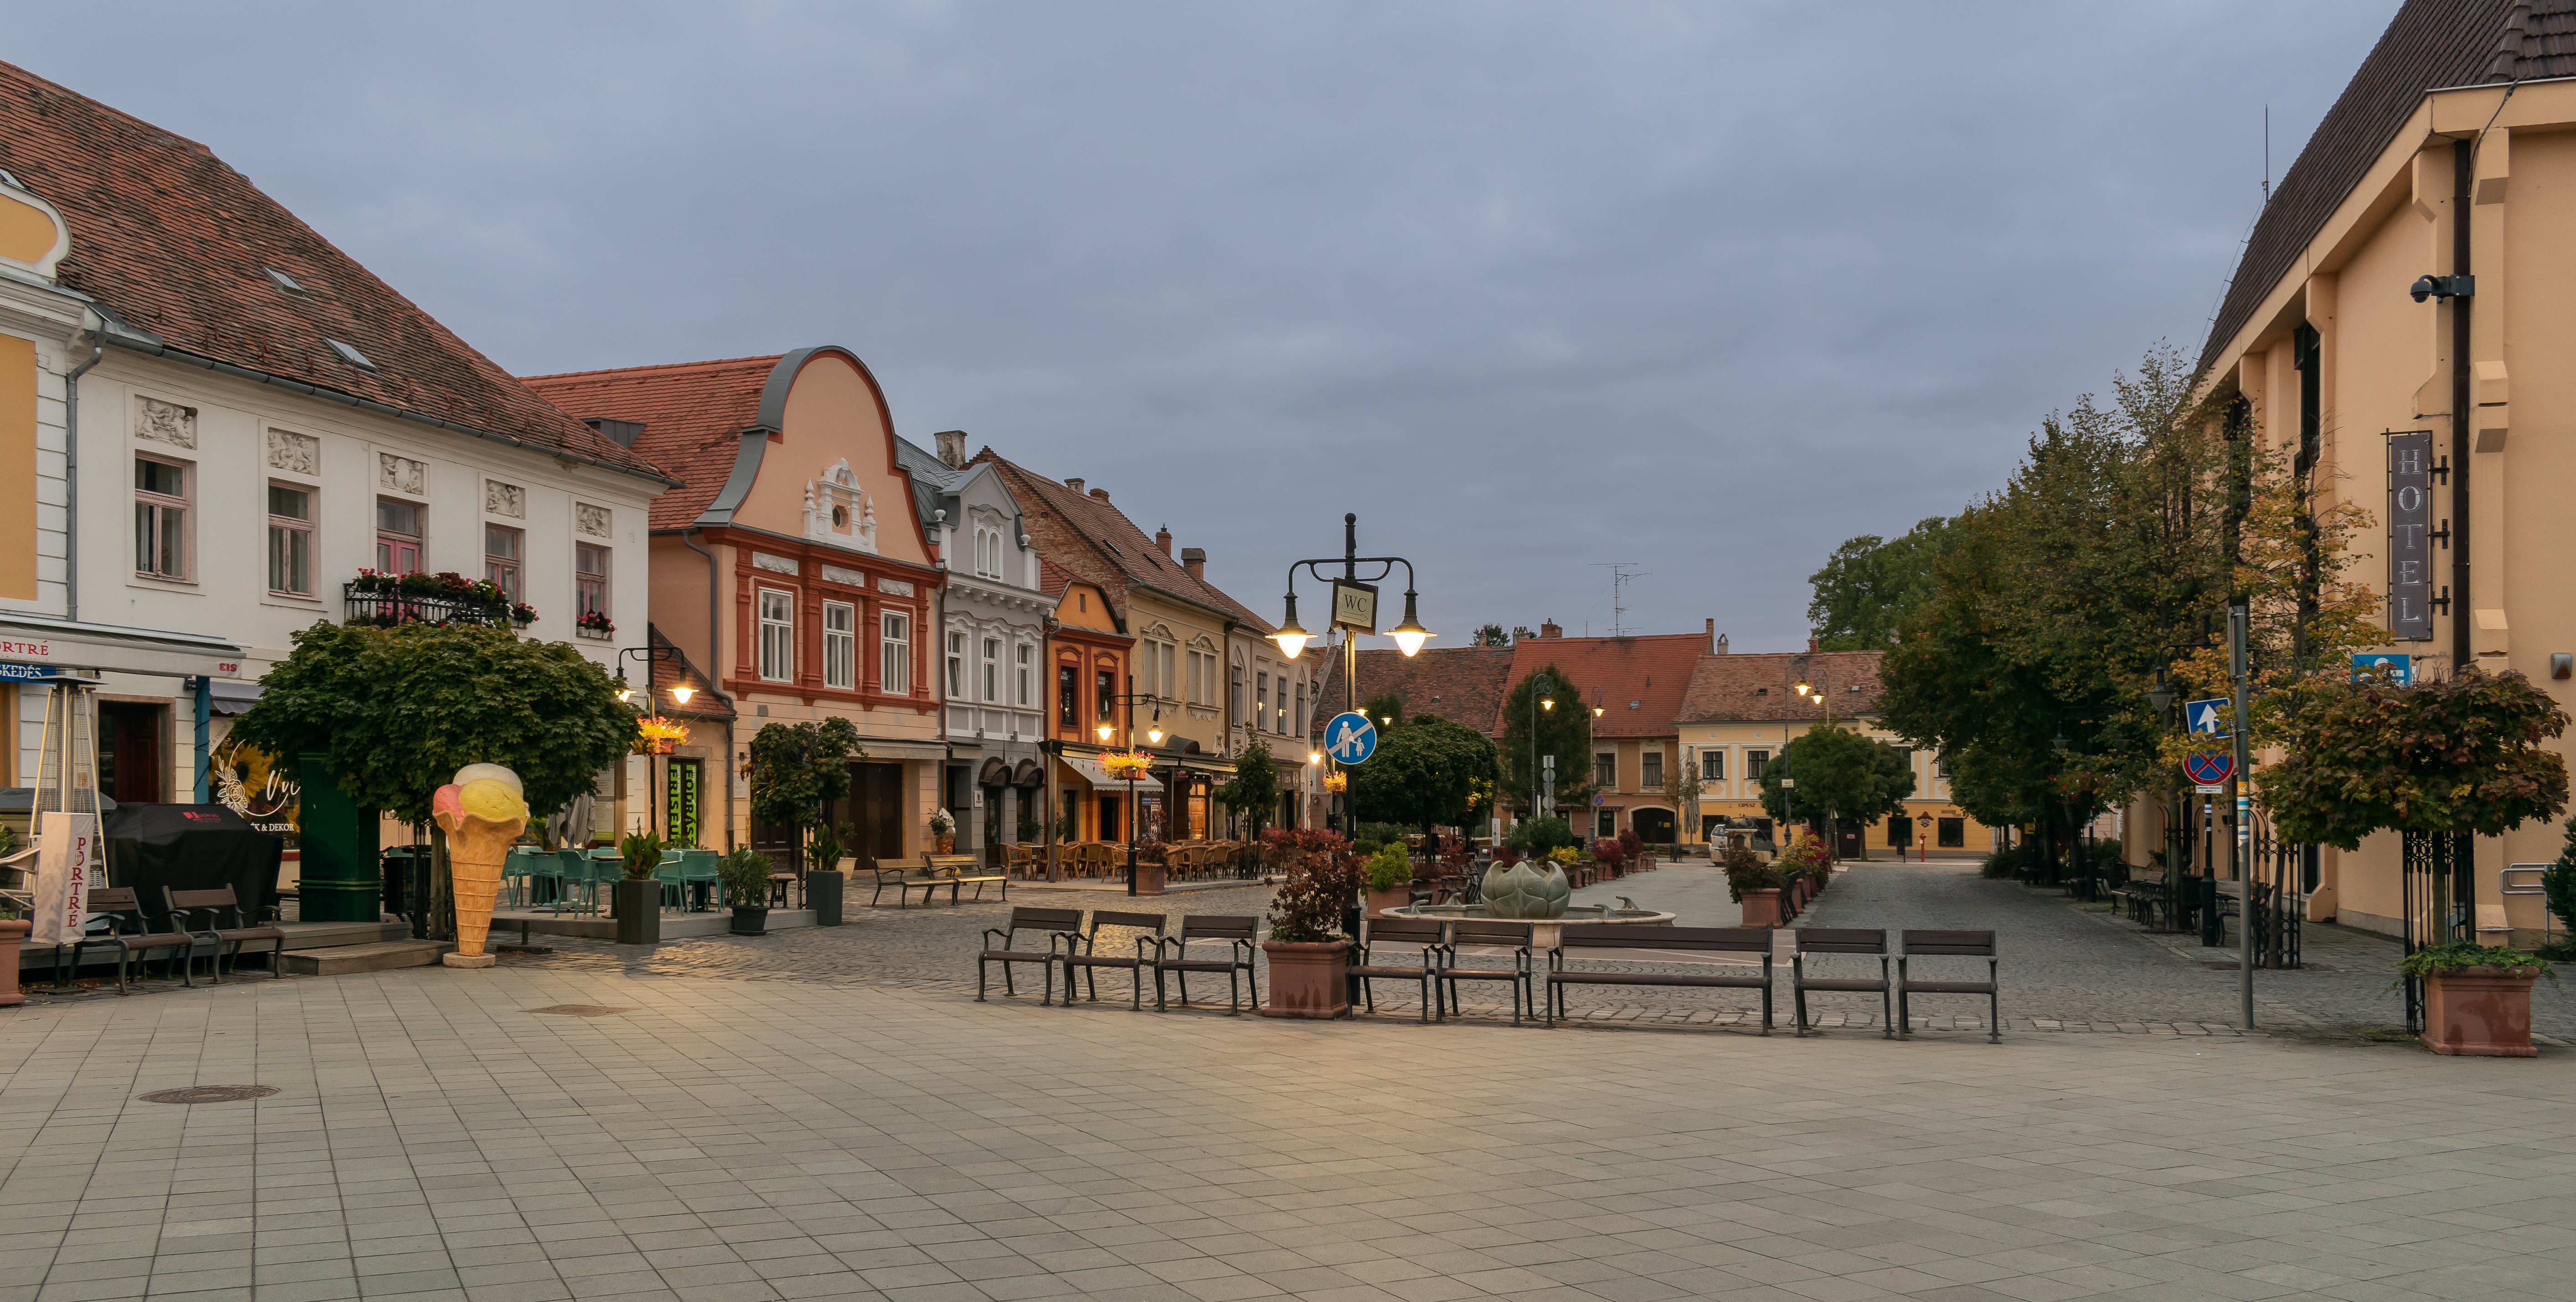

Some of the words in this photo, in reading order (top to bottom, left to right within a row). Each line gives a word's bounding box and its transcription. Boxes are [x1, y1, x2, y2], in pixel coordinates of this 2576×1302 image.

[2397, 449, 2423, 623] HOTEL
[1344, 594, 1367, 613] WC
[0, 640, 49, 656] RTRÉ
[0, 664, 42, 679] KEDÉS
[219, 663, 237, 672] EIS
[67, 837, 87, 927] PORTRÉ
